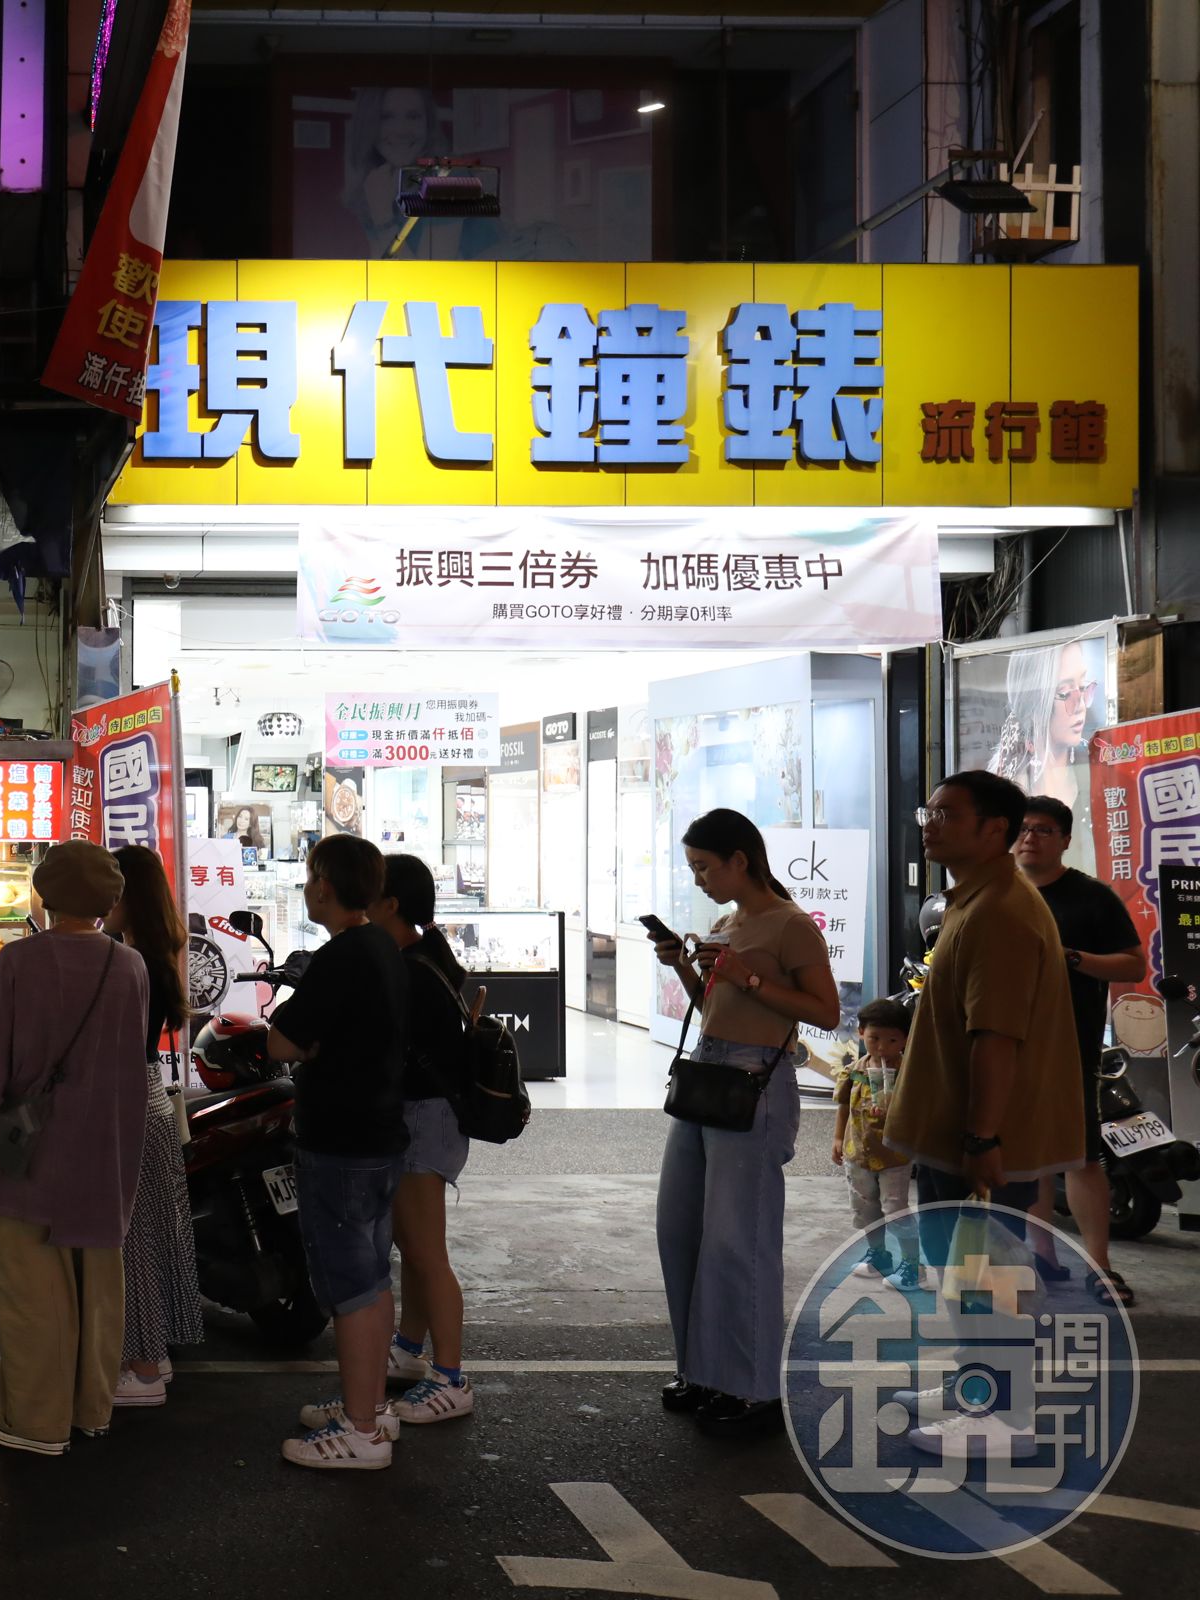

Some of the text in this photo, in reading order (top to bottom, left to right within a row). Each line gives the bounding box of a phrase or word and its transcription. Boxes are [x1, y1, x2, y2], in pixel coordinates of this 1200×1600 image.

[921, 400, 1107, 462] 流行館
[396, 548, 843, 591] 振興三倍券 加碼優惠中
[319, 608, 401, 624] GOTO
[640, 604, 733, 622] 分期享0利率
[335, 702, 421, 720] 全民振興月
[425, 699, 479, 711] 您用振興券
[545, 720, 569, 736] GOTO
[589, 729, 607, 740] LACOSTE
[500, 741, 525, 757] FOSSIL
[1103, 786, 1132, 880] 歡迎使用
[788, 841, 829, 881] ck
[190, 865, 235, 886] 享有
[785, 887, 848, 901] 系列款式
